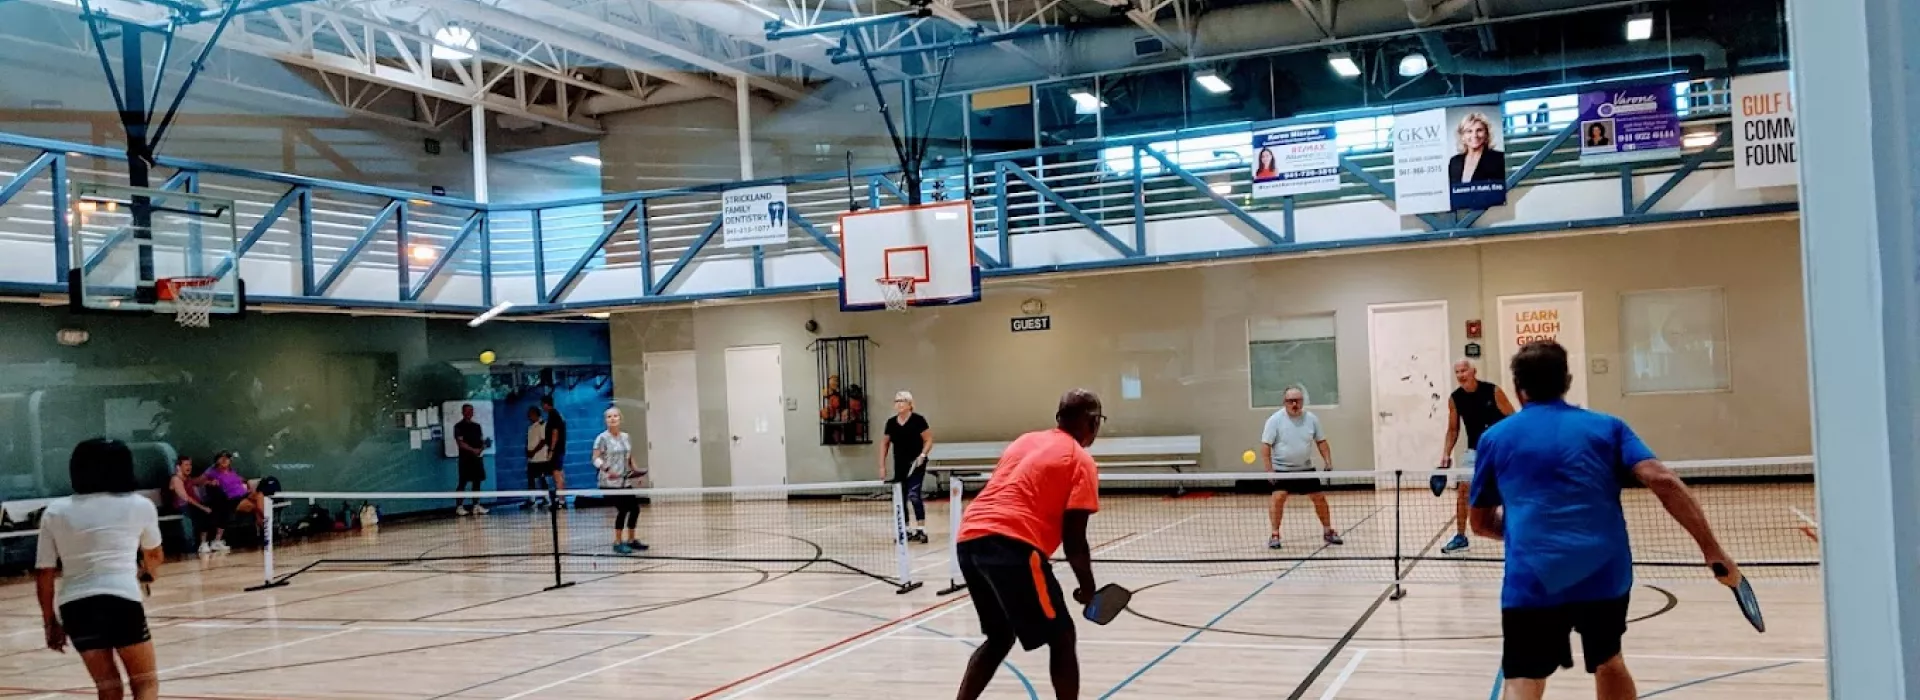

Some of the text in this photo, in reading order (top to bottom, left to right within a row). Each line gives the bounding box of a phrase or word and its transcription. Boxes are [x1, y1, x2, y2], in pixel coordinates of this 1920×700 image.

[1614, 90, 1656, 105] Varone
[1742, 93, 1781, 116] GULF
[1398, 125, 1441, 141] GKW
[1291, 144, 1325, 153] RE/MAX
[725, 193, 772, 204] STRICKLAND
[725, 205, 751, 214] FAMILY
[725, 214, 767, 225] DENTISTRY
[1516, 310, 1558, 322] LEARN
[1013, 318, 1048, 330] GUEST
[1516, 322, 1560, 334] LAUGH
